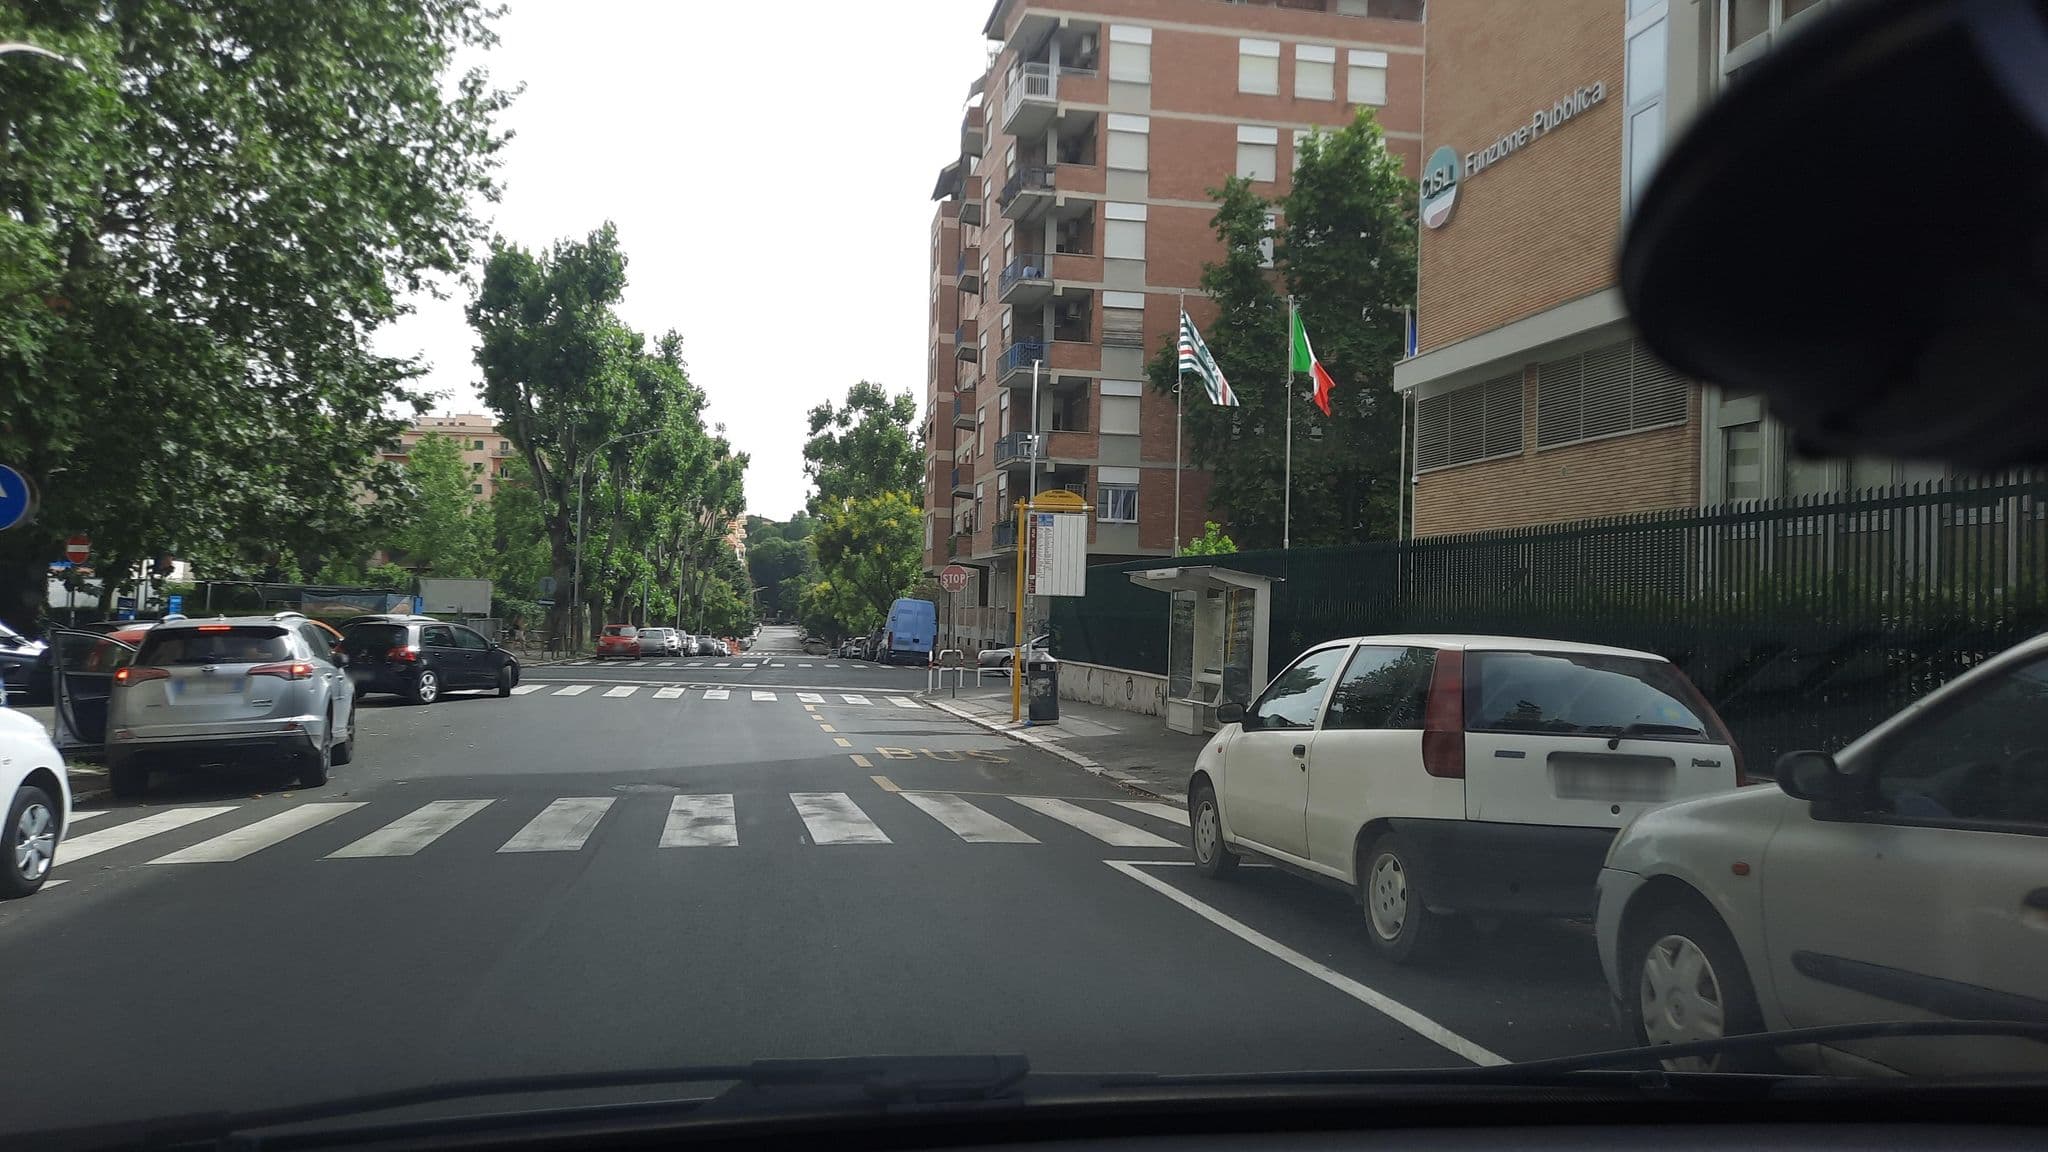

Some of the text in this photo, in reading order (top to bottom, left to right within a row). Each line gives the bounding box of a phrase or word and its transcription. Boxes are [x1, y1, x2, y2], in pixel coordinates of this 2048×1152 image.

[1464, 80, 1605, 178] Funzione Pubblica
[1421, 165, 1454, 200] CISL
[943, 573, 966, 584] STOP
[875, 747, 1009, 763] BUS
